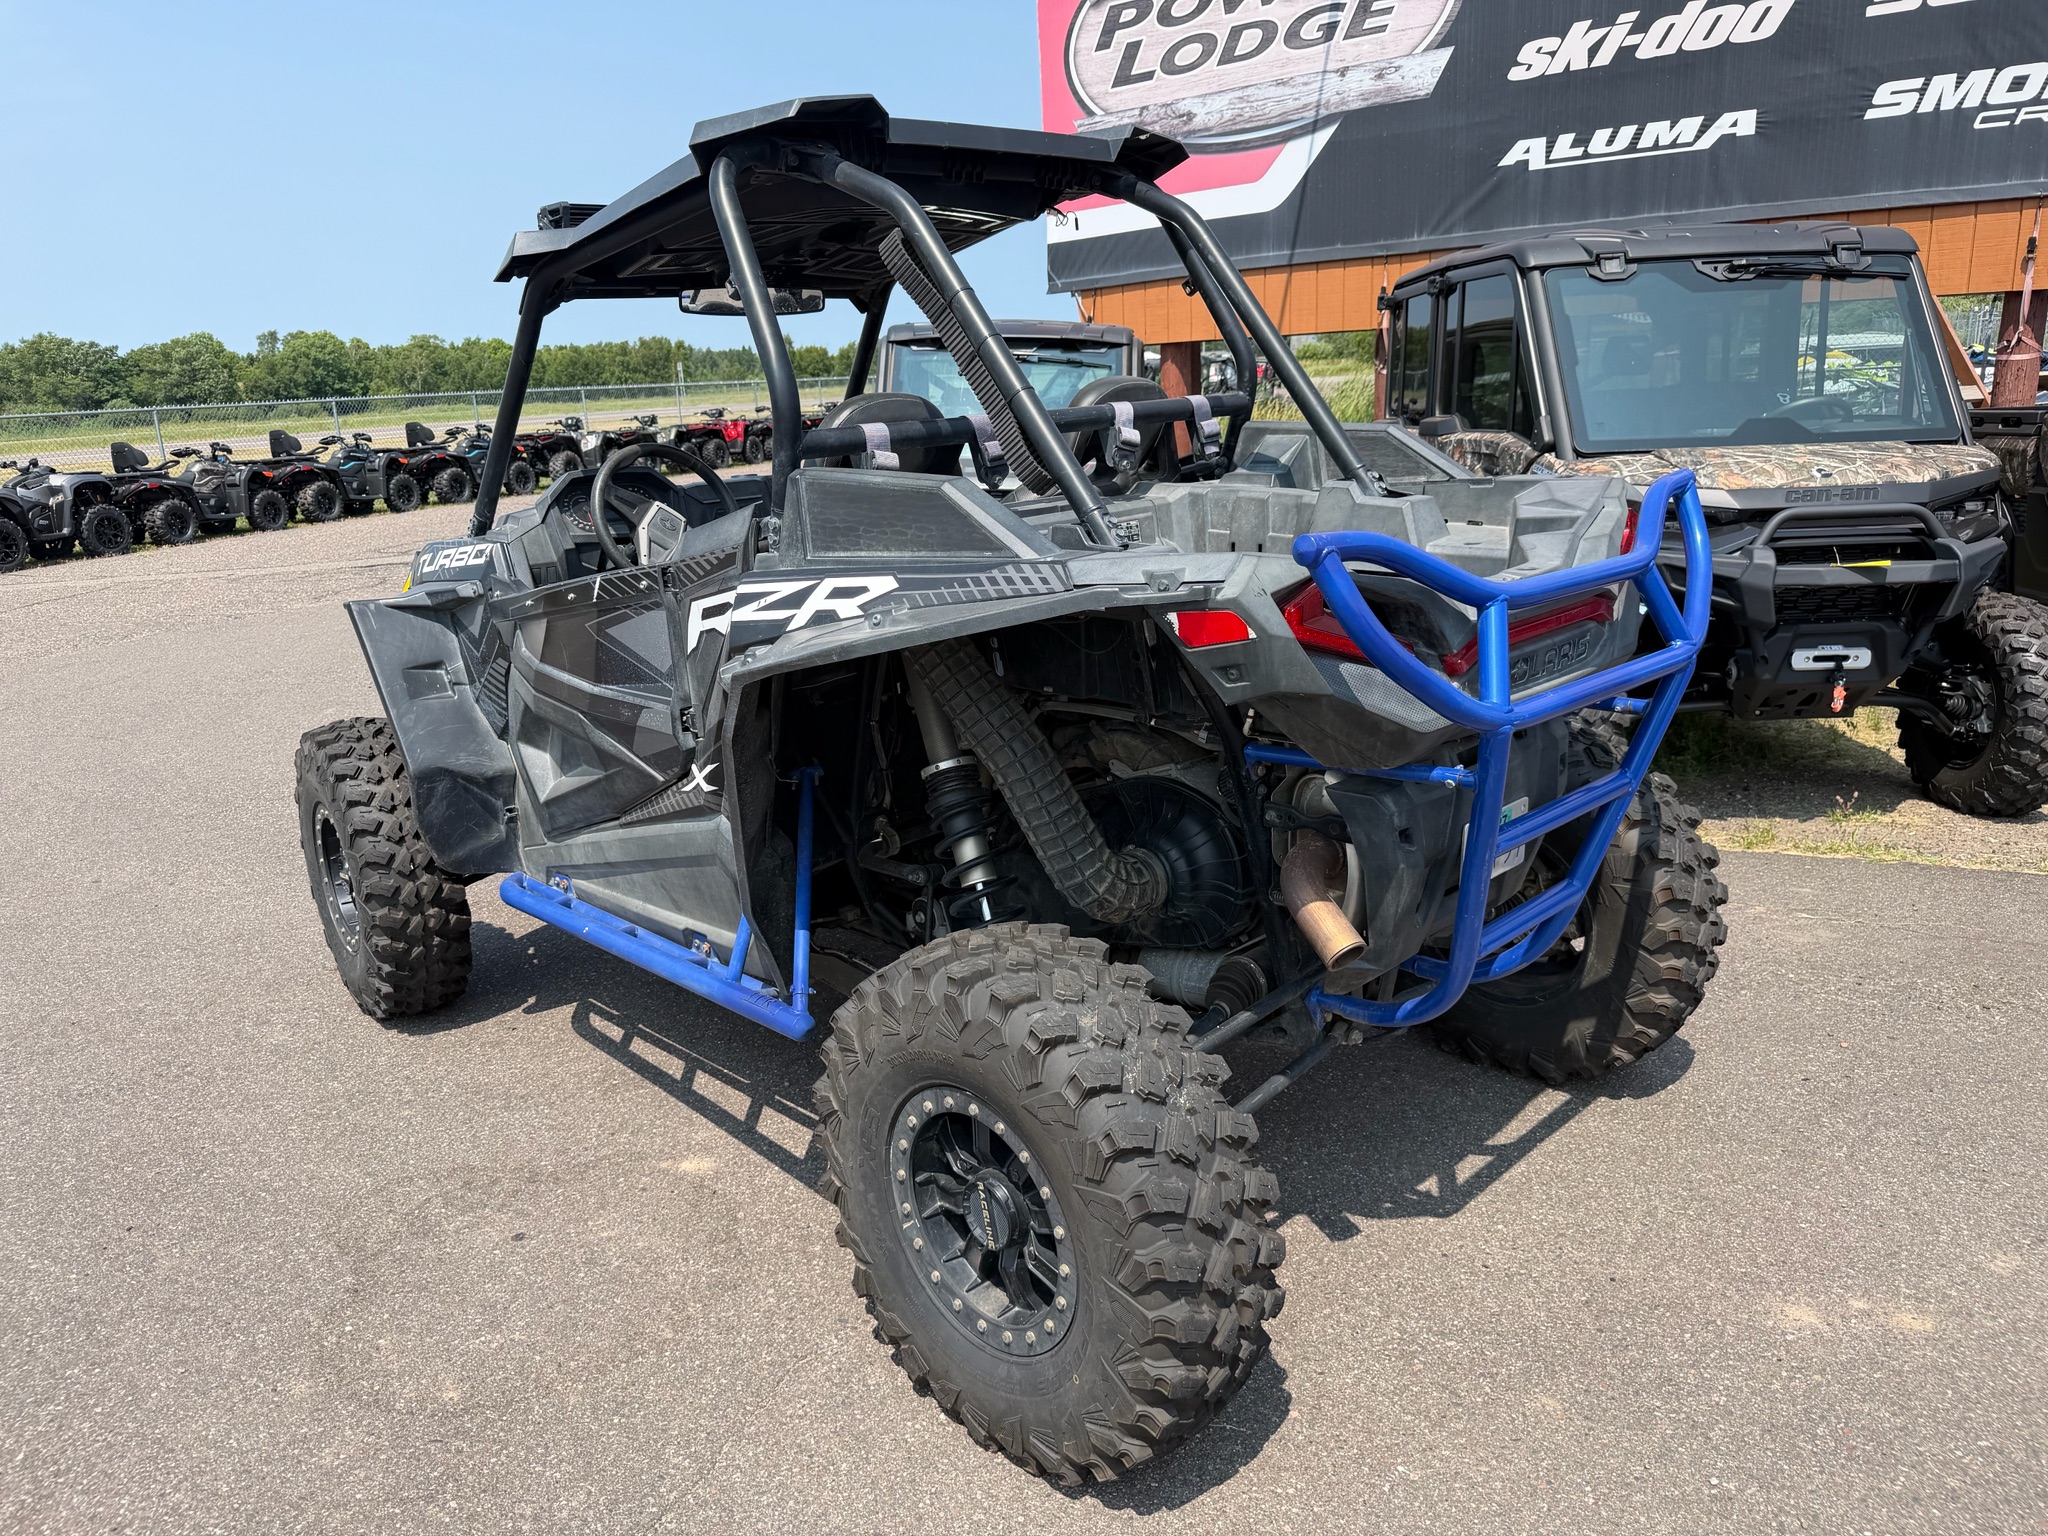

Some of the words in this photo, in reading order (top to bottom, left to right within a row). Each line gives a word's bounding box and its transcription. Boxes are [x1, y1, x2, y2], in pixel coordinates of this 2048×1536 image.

[1110, 0, 1397, 89] LODGE
[1507, 0, 1797, 81] ski-doo
[1863, 62, 2048, 120] SMO
[1497, 109, 1758, 170] ALUMA
[1784, 487, 1881, 504] can-am
[417, 543, 494, 577] TURBO
[687, 574, 900, 656] RZR
[1510, 632, 1592, 686] OLARIS
[976, 1181, 996, 1251] RACELINE
